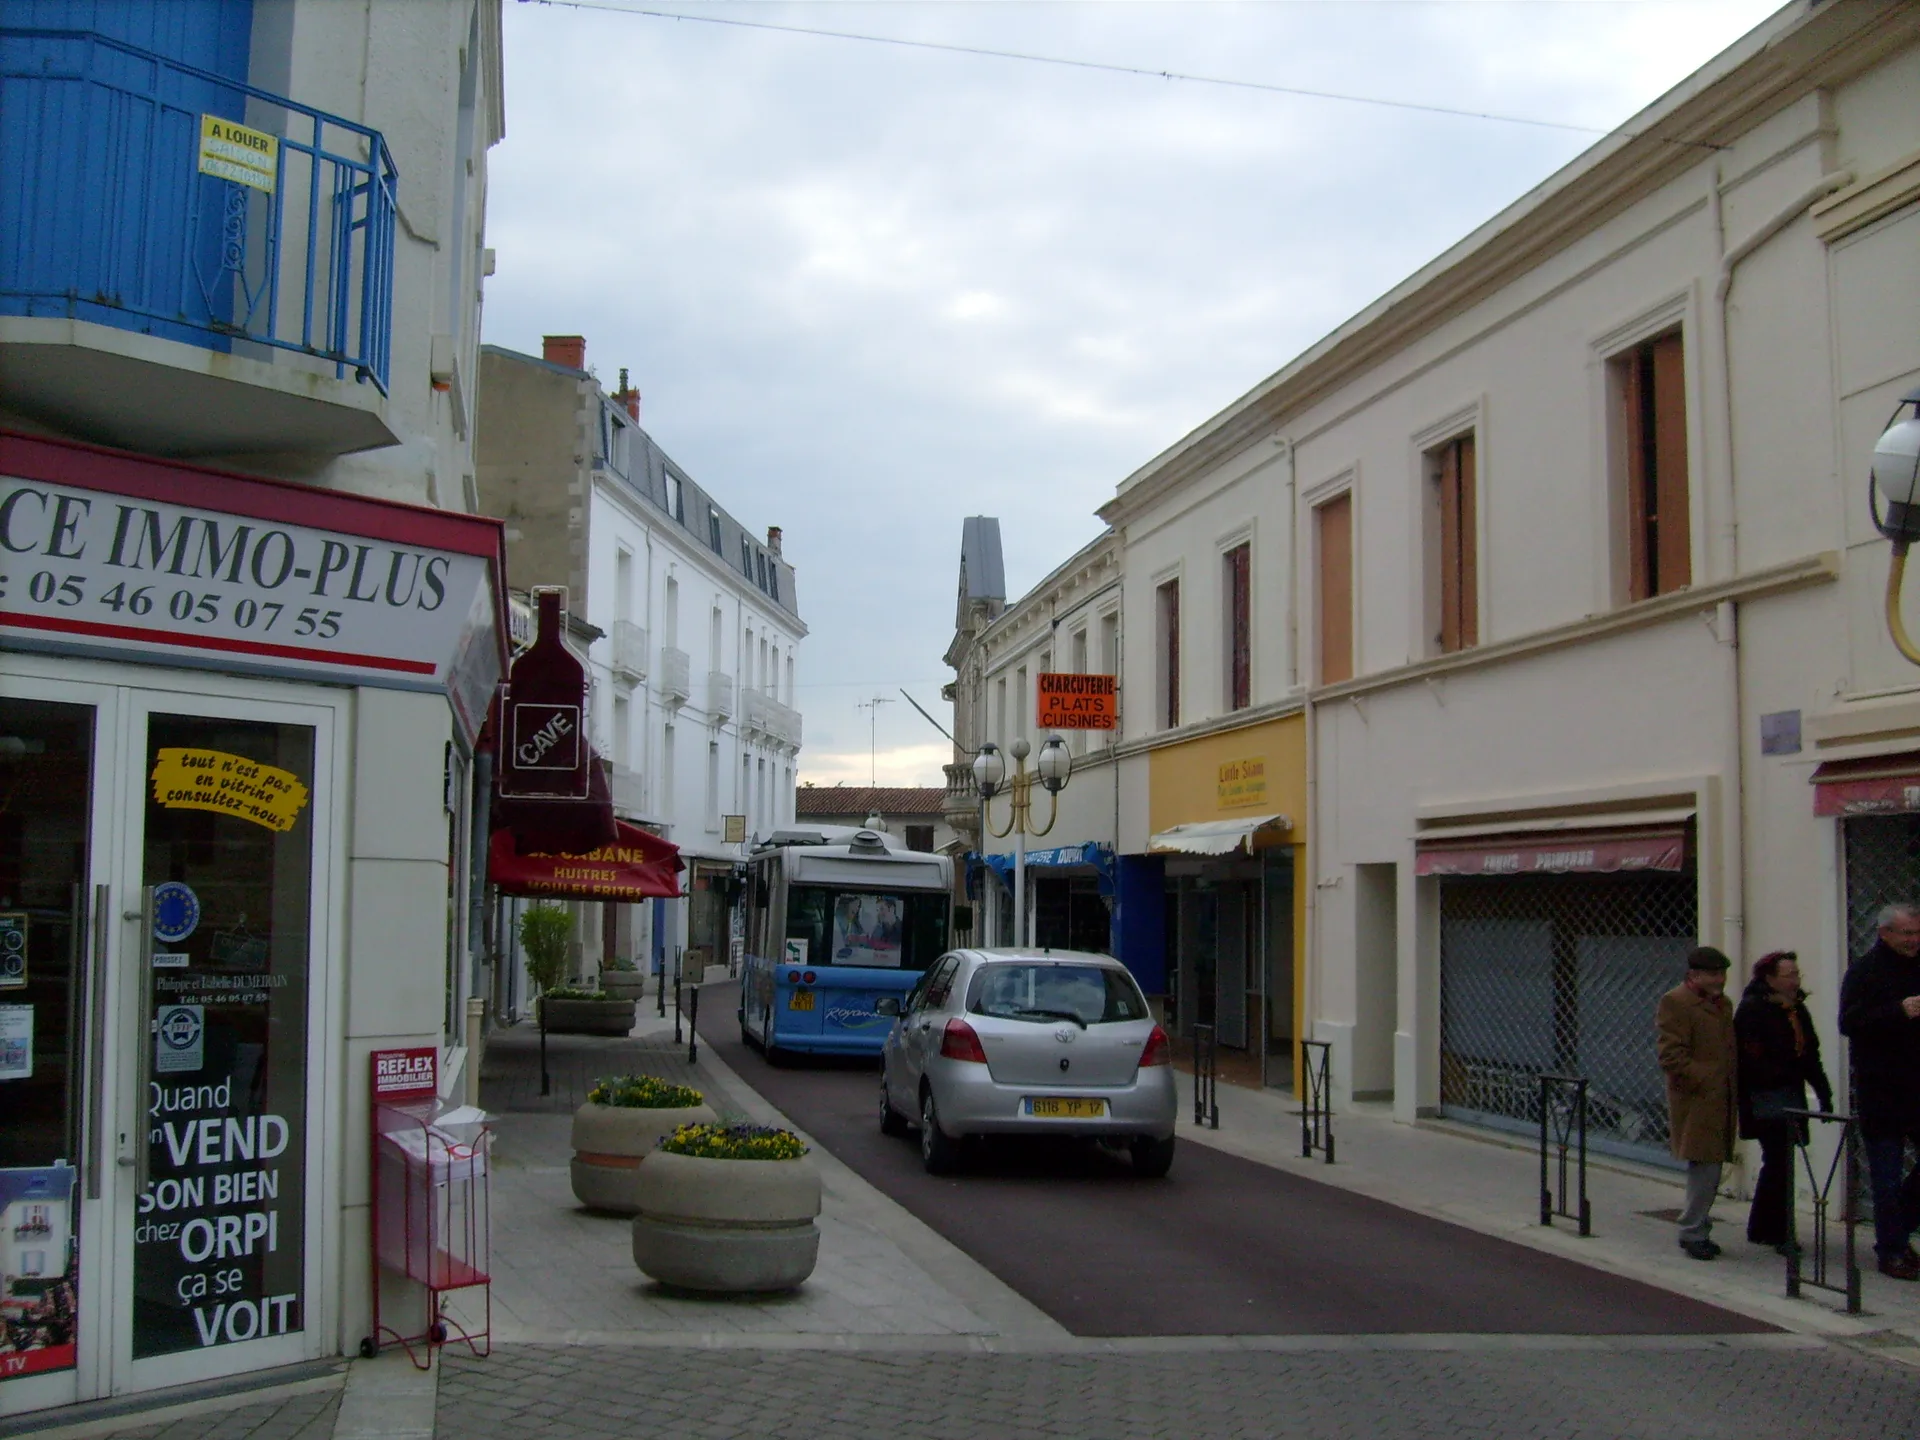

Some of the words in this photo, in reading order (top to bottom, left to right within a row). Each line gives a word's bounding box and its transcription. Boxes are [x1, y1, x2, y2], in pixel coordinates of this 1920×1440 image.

[212, 124, 221, 137] A
[226, 128, 268, 152] LOUER
[0, 488, 91, 560] CE
[104, 504, 451, 611] IMMO-PLUS
[30, 570, 87, 607] 05
[100, 581, 153, 615] 46
[170, 589, 221, 623] 05
[235, 598, 284, 632] 07
[294, 607, 343, 639] 55
[1041, 675, 1113, 695] CHARCUTERIE
[1050, 696, 1104, 711] PLATS
[1043, 713, 1111, 728] CUISINES
[519, 712, 574, 765] CAVE
[181, 754, 215, 768] tout
[222, 759, 260, 779] n'est
[263, 774, 293, 794] pas
[195, 775, 214, 786] en
[221, 778, 274, 803] vitrine
[166, 789, 286, 828] consultez-nous
[554, 867, 617, 881] HUITRES
[593, 884, 642, 897] FRITES
[377, 1056, 433, 1075] REFLEX
[377, 1072, 433, 1085] IMMOBILIER
[150, 1075, 231, 1116] Quand
[1067, 1101, 1081, 1113] YP
[1090, 1102, 1101, 1114] 17
[164, 1114, 290, 1167] VEND
[139, 1176, 204, 1213] SON
[214, 1169, 278, 1205] BIEN
[135, 1219, 181, 1244] chez
[180, 1210, 277, 1263] ORPI
[177, 1272, 207, 1305] ça
[215, 1267, 243, 1295] se
[194, 1293, 296, 1347] VOIT
[7, 1357, 27, 1370] TV
